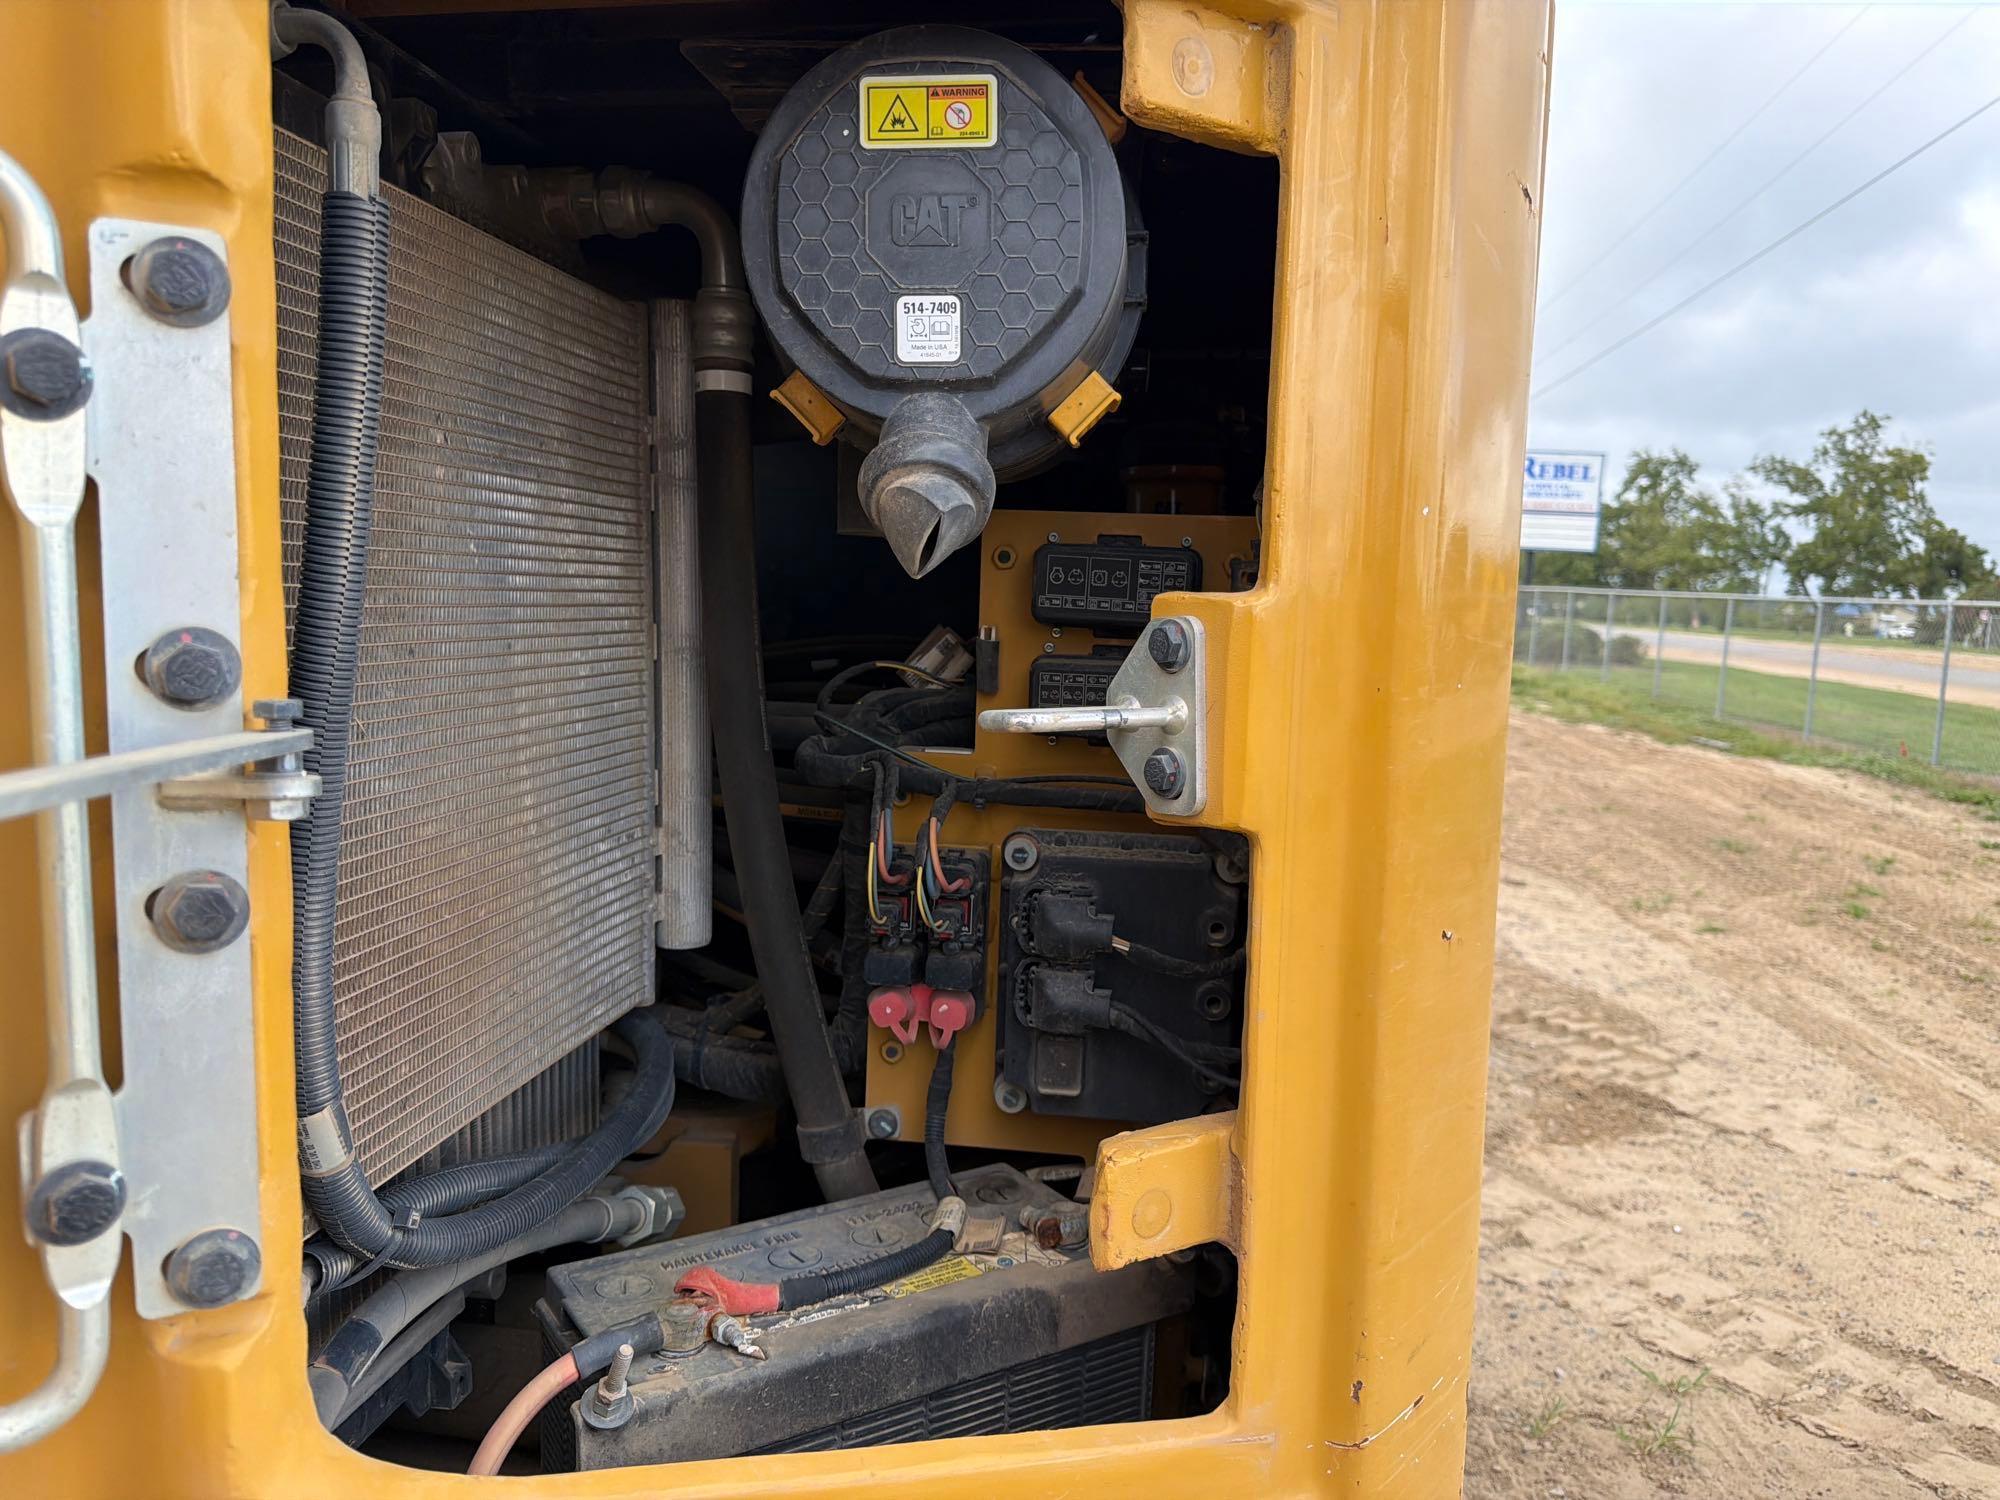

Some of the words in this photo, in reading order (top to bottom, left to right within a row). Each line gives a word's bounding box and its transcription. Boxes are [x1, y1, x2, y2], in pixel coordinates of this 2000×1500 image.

[941, 88, 985, 96] WARNING
[903, 301, 957, 314] 514-7409
[660, 1241, 761, 1272] MAINTENANCE
[763, 1230, 803, 1247] FREE
